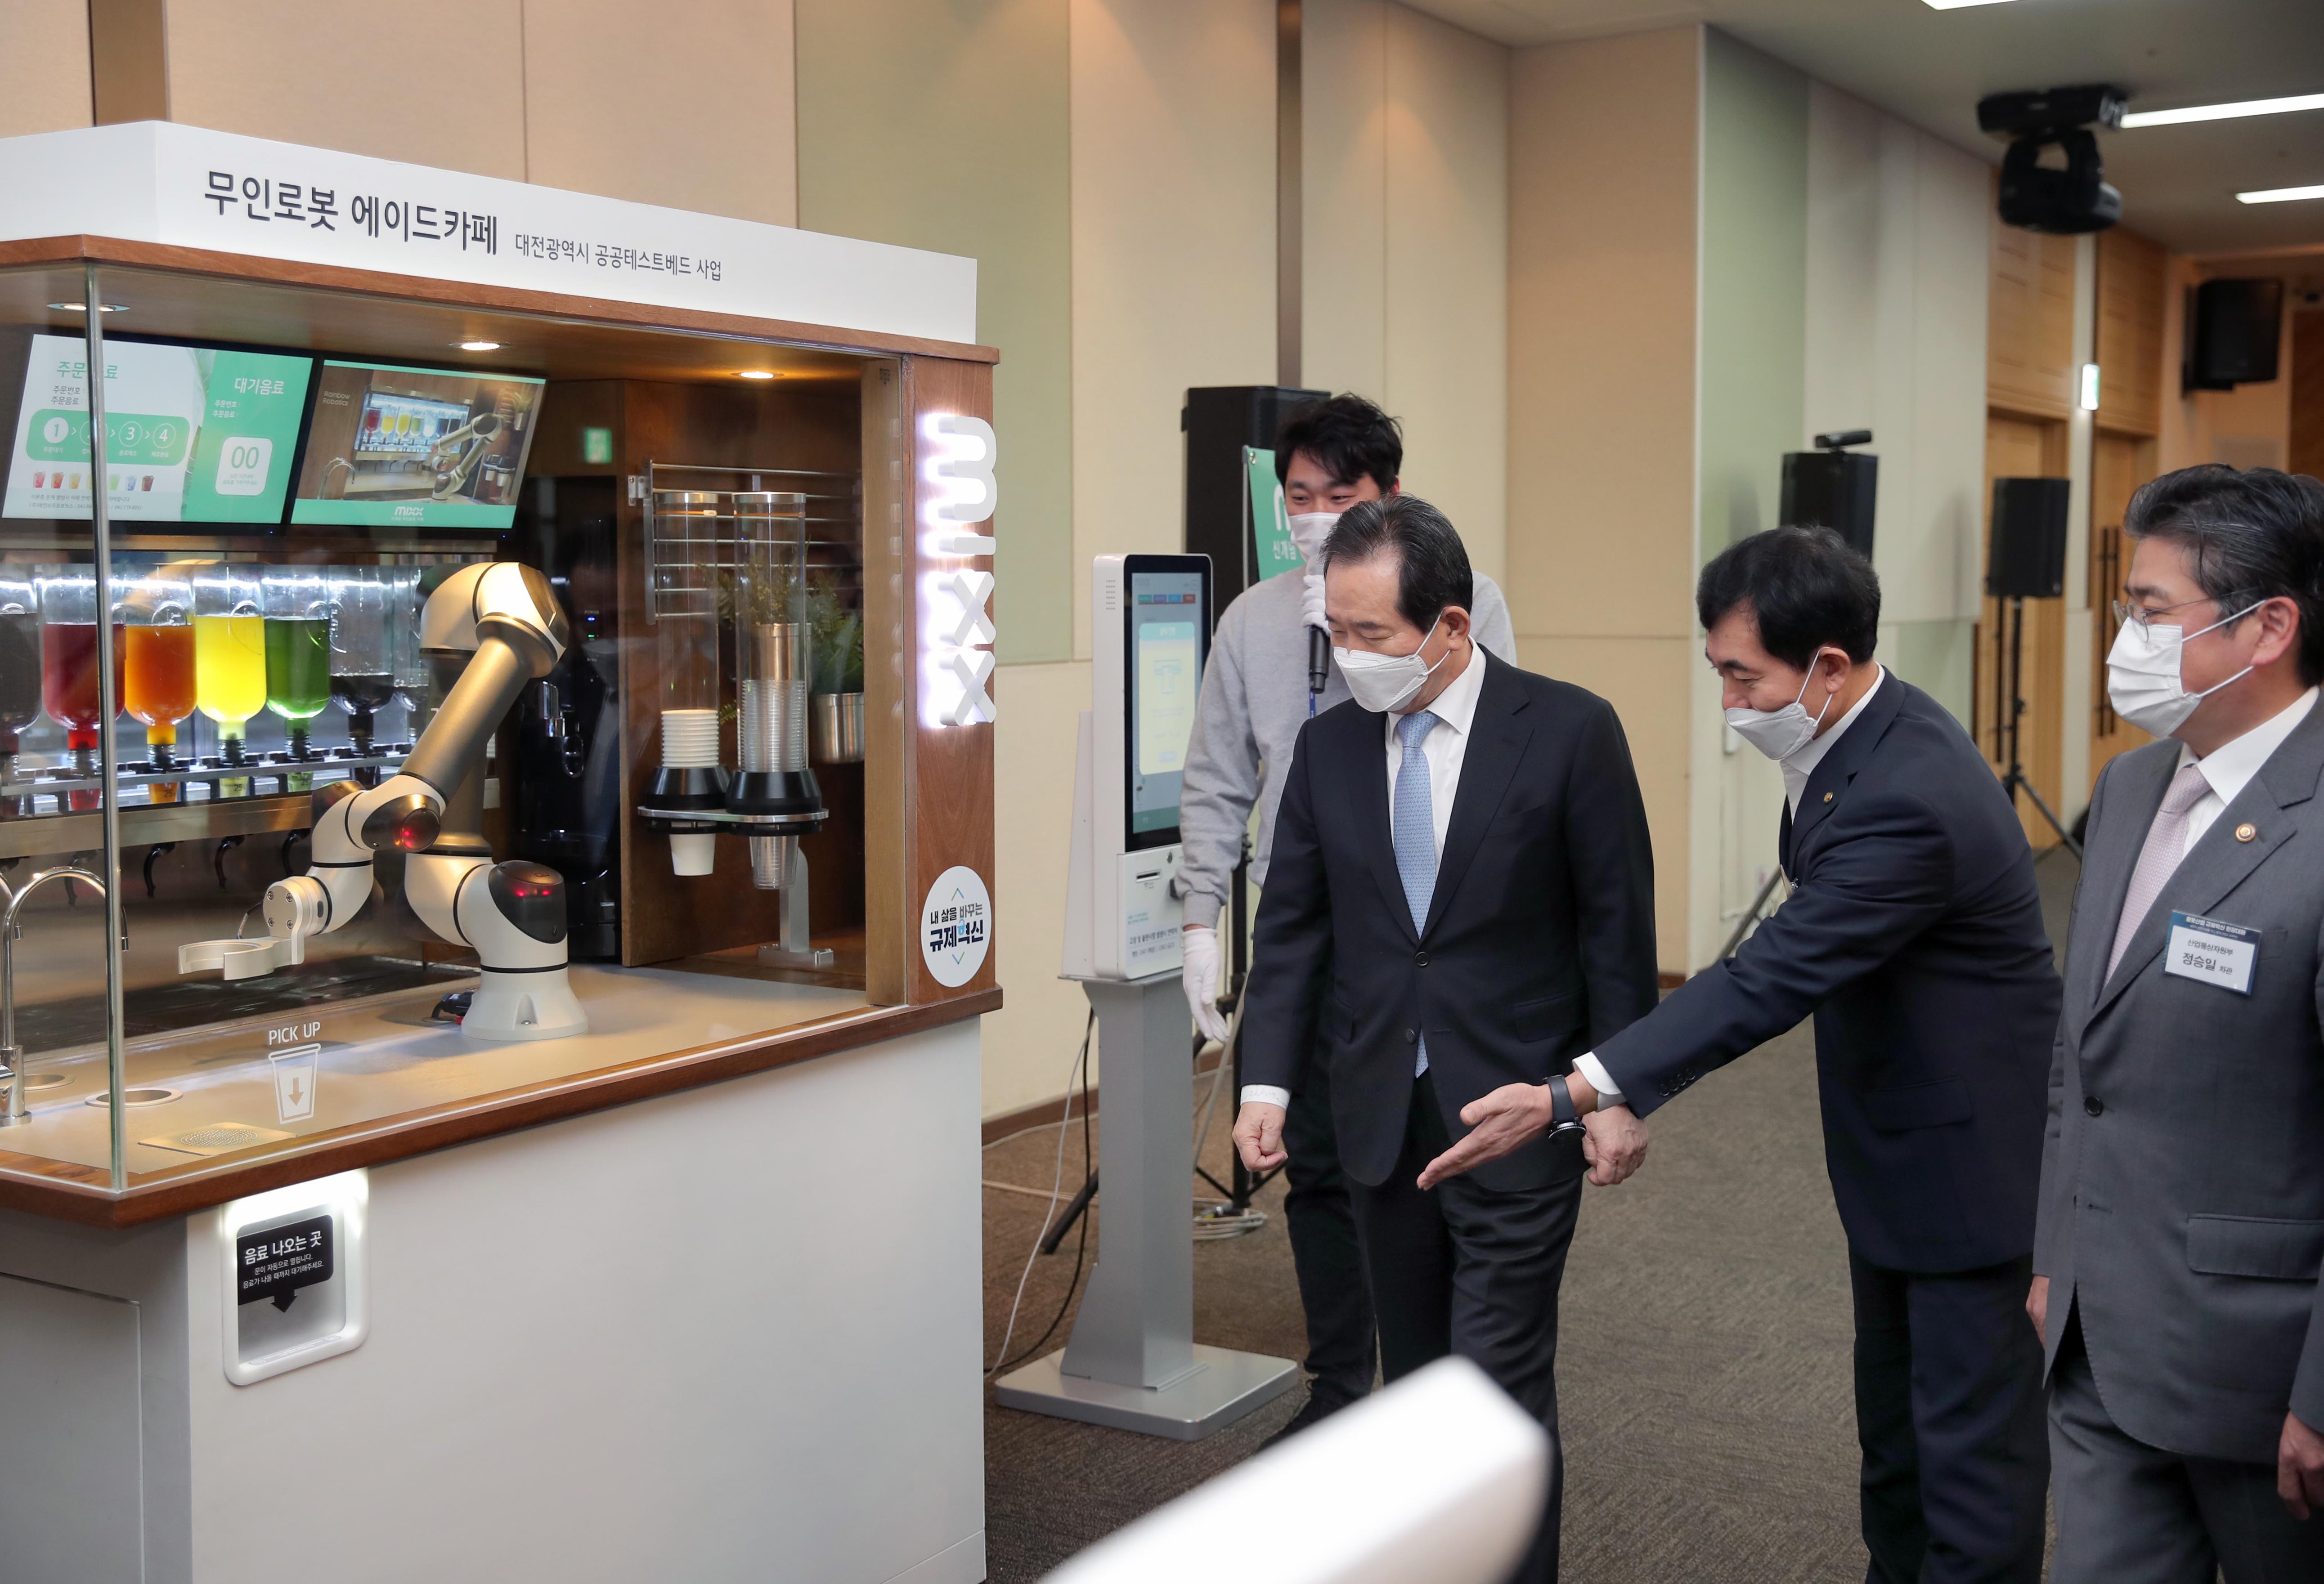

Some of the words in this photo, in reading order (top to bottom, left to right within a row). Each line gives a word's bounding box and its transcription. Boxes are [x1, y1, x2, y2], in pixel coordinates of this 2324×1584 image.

[204, 170, 338, 232] 무인로봇
[351, 193, 498, 255] 에이드카페
[515, 233, 590, 265] 대전광역시
[595, 244, 691, 277] 공공테스트베드
[696, 258, 722, 282] 사업
[57, 361, 118, 379] 주문료
[53, 385, 81, 395] 주문번호
[234, 378, 284, 395] 대기음료
[324, 391, 350, 399] Rainbow
[51, 396, 79, 405] 주문음료
[54, 424, 59, 437] 1
[126, 427, 135, 440] 3
[159, 429, 168, 442] 4
[231, 446, 259, 469] 00
[930, 910, 938, 924] 내
[941, 907, 957, 922] 삶을
[959, 902, 983, 918] 바꾸는
[930, 919, 983, 952] 규제혁신
[2188, 939, 2233, 956] 산업통상자원부
[2183, 953, 2216, 971] 정승일
[2219, 966, 2233, 975] 차관
[269, 1025, 298, 1045] PICK
[303, 1021, 321, 1038] UP
[245, 1245, 269, 1265] 음료
[272, 1237, 307, 1256] 나오는
[310, 1231, 322, 1248] 곳
[243, 1279, 260, 1289] 음료가
[261, 1275, 272, 1284] 나올
[274, 1270, 290, 1281] 때까지
[291, 1261, 324, 1277] 대기해주세요.
[255, 1266, 266, 1275] 문이
[267, 1261, 289, 1273] 자동으로
[290, 1253, 313, 1266] 열립니다.
